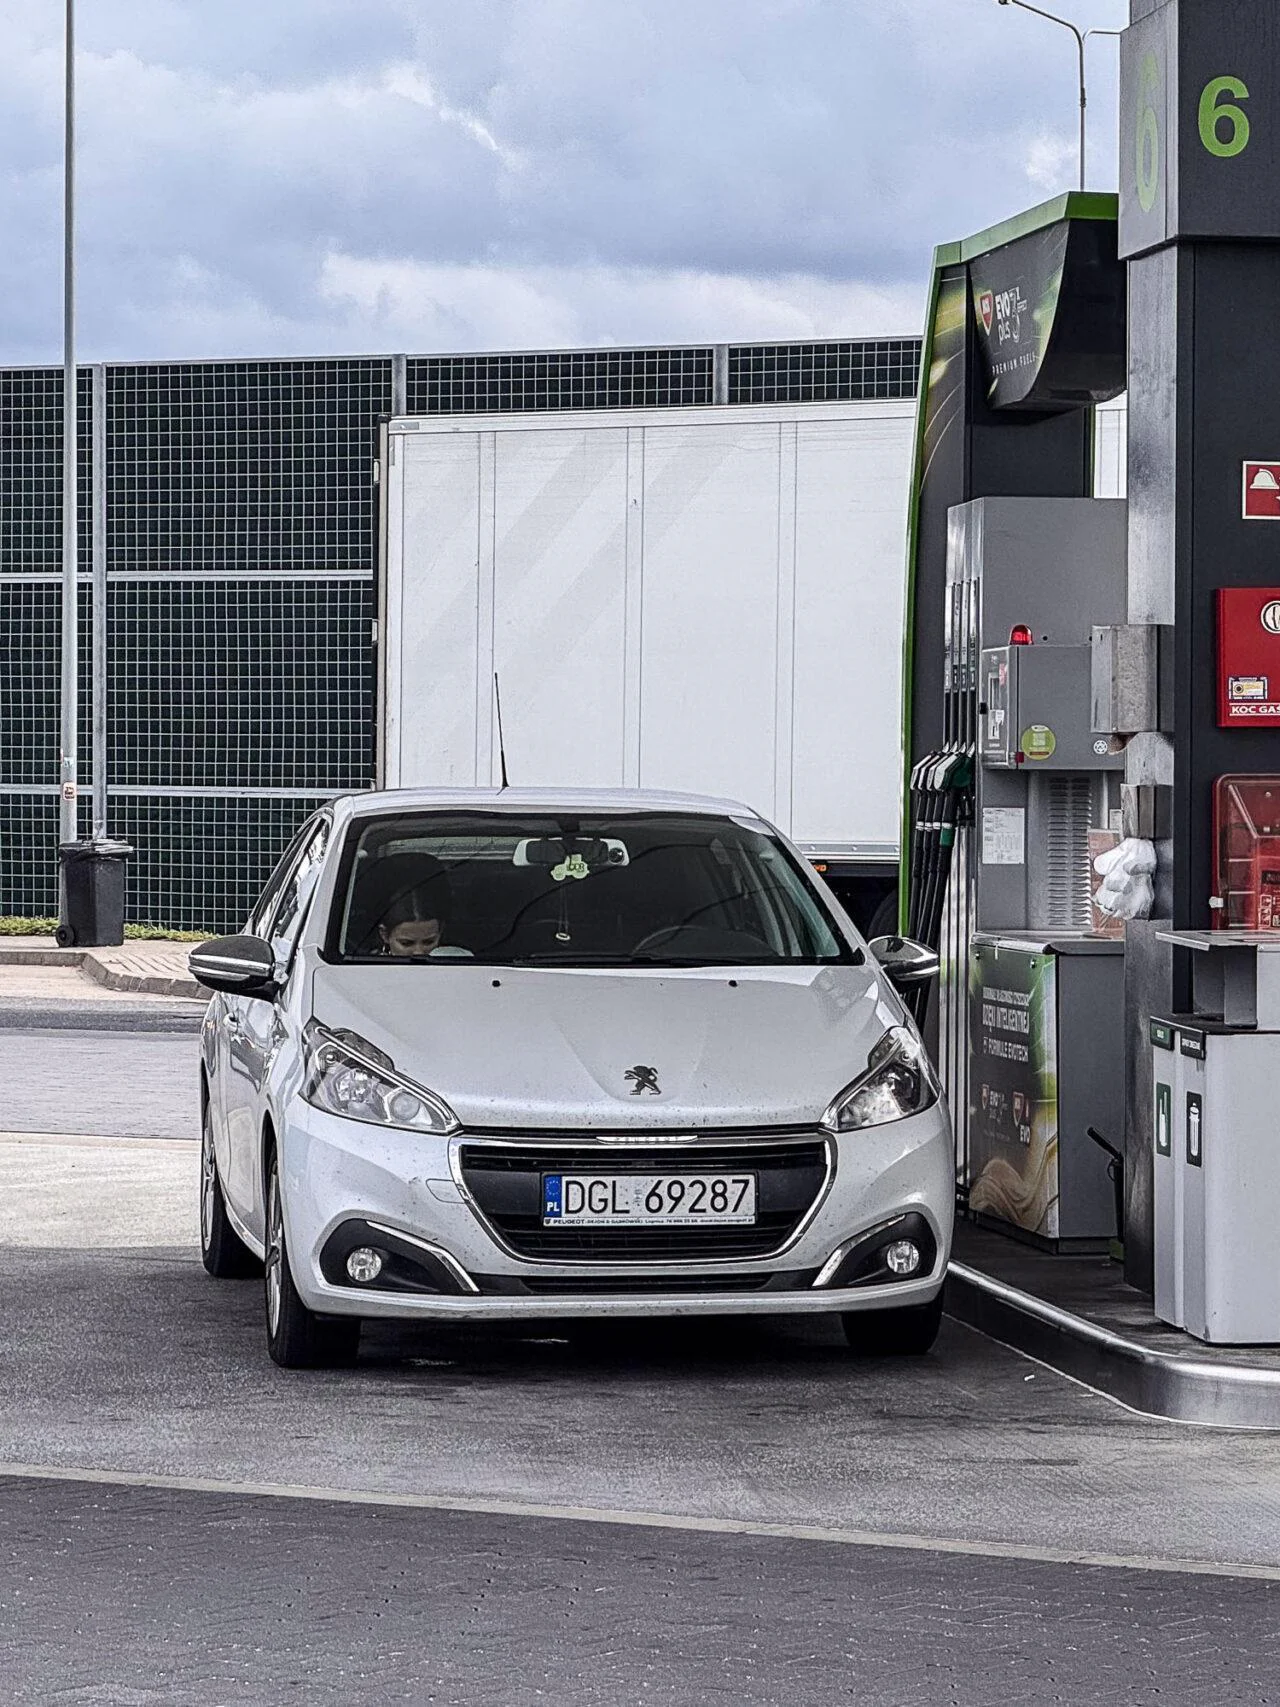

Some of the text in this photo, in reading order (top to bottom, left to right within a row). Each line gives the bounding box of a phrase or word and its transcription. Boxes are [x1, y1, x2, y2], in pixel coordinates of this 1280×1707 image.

[1197, 75, 1250, 158] 6
[995, 291, 1011, 320] EVO
[1231, 705, 1257, 714] KOC
[546, 1202, 560, 1212] PL
[564, 1178, 750, 1215] DGL 69287
